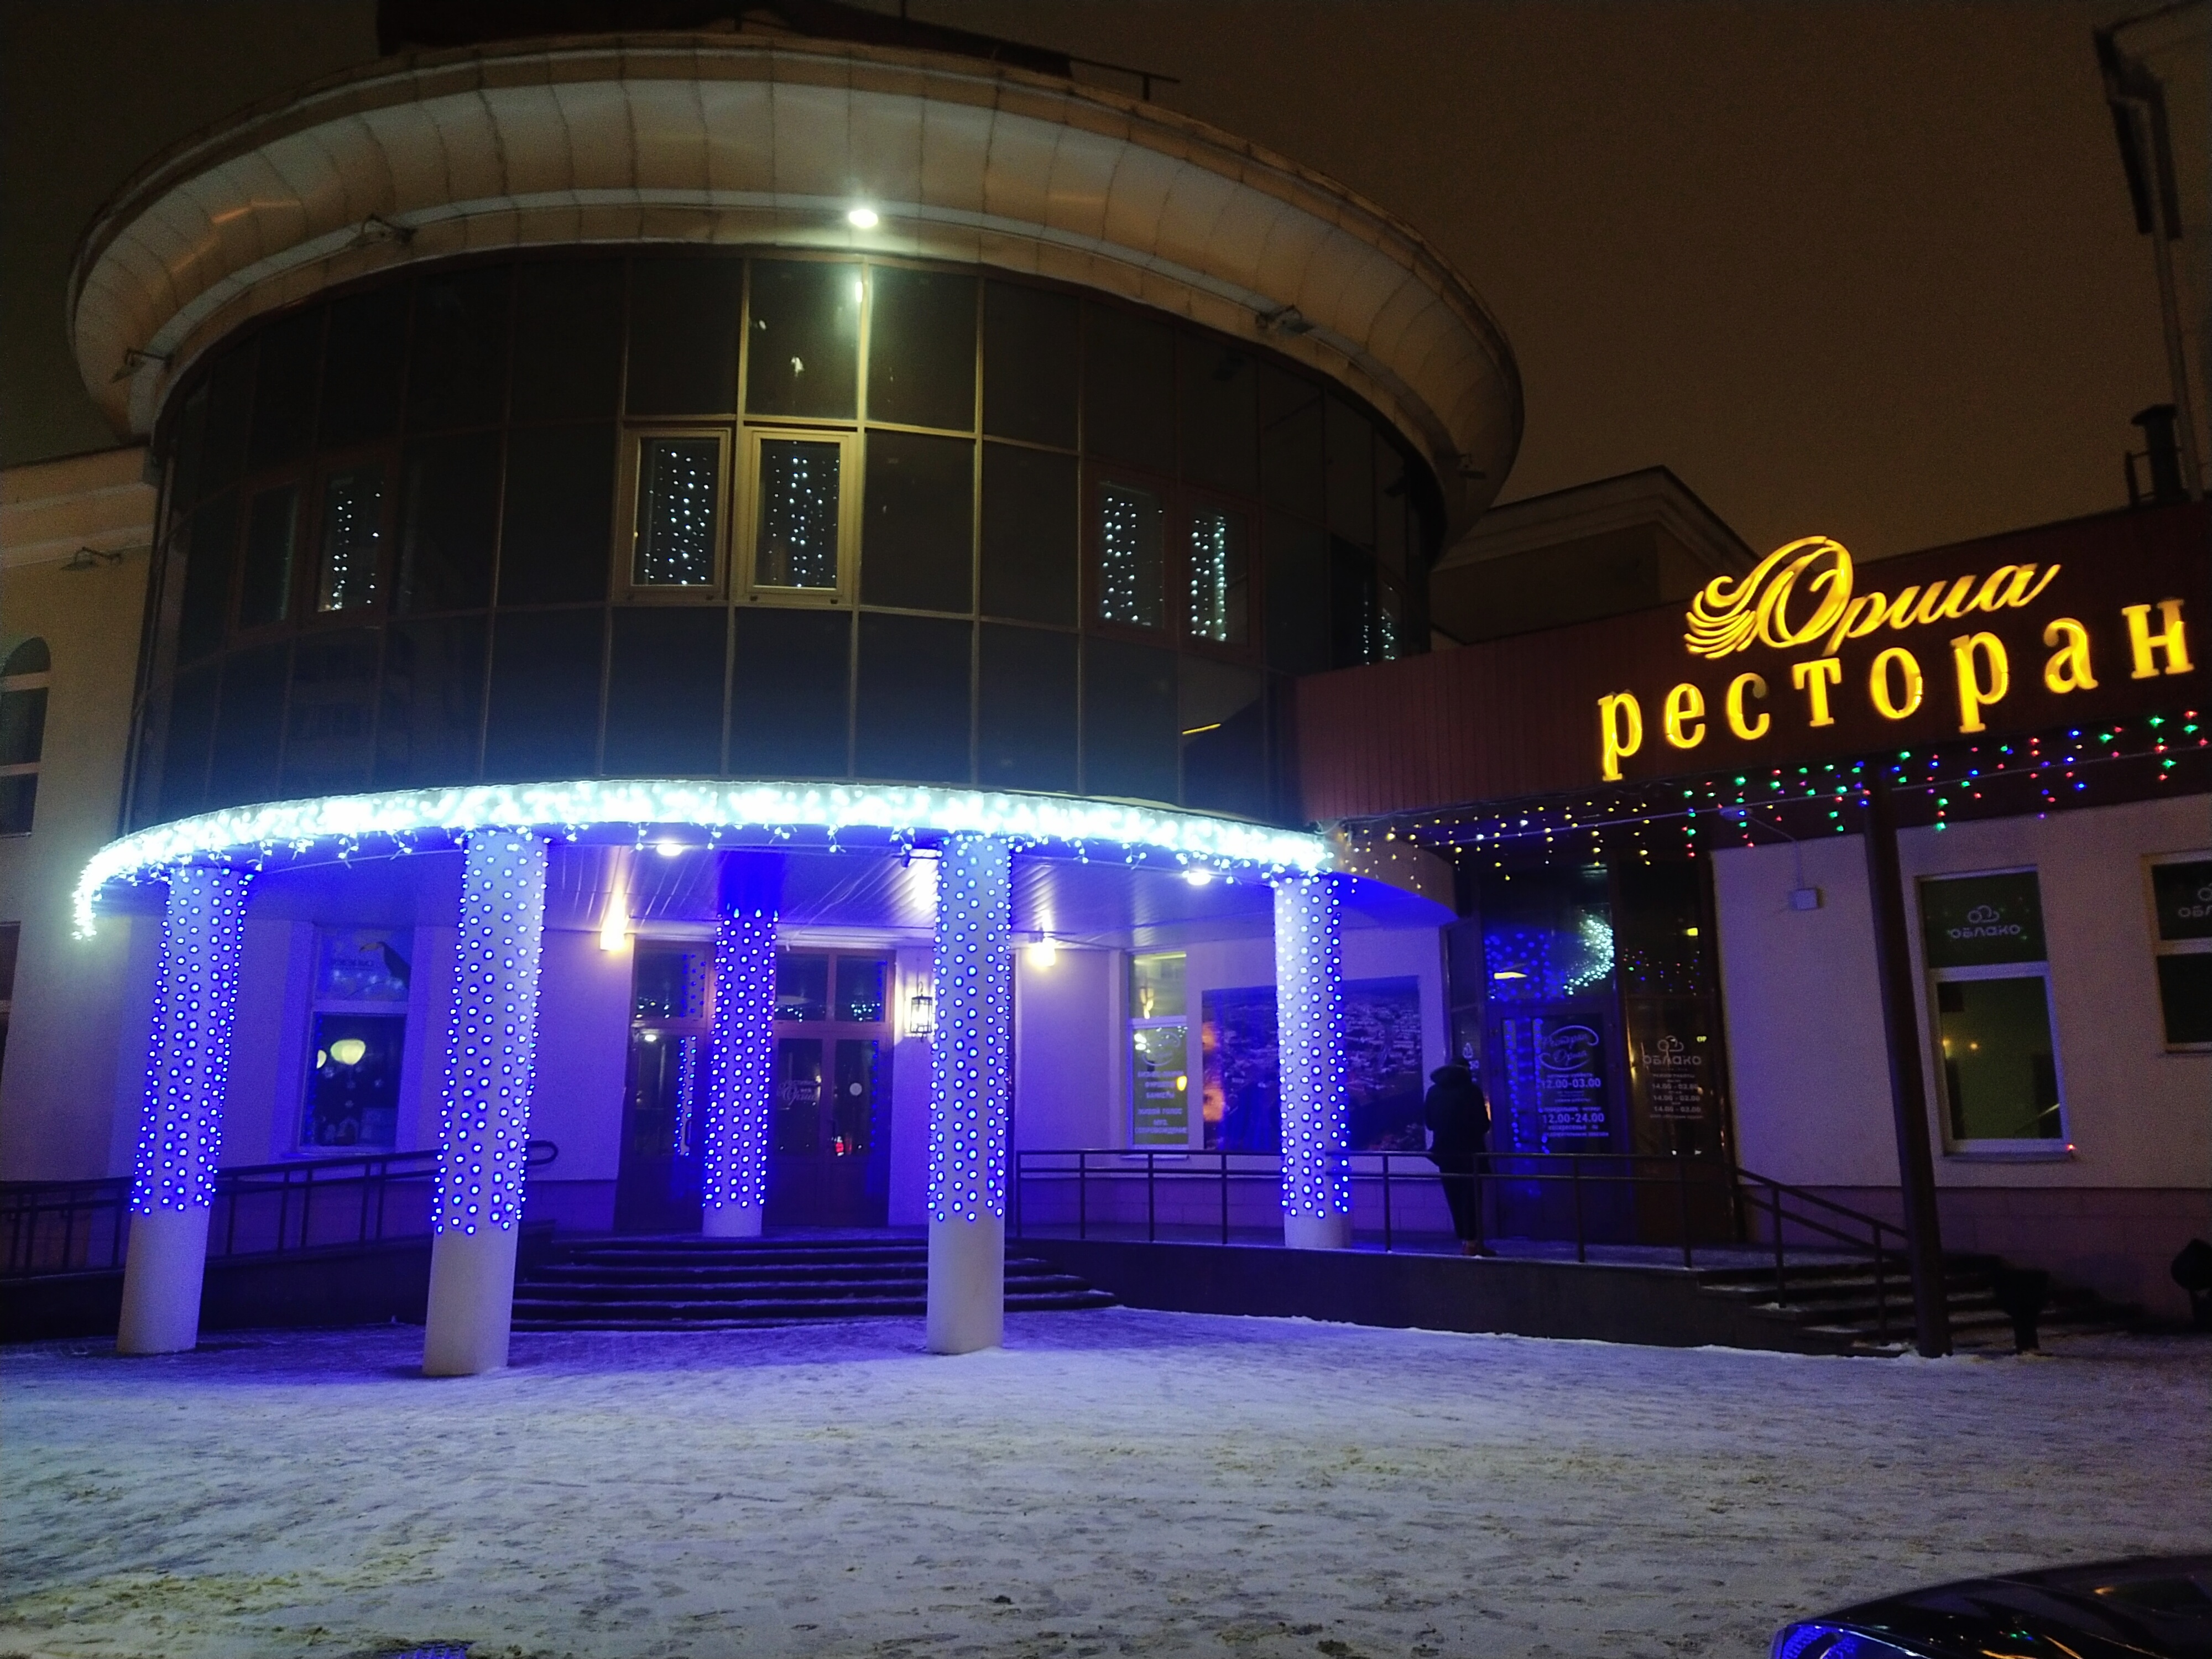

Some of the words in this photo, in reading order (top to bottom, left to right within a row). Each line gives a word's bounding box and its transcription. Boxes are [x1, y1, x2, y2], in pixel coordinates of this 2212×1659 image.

[1742, 535, 2062, 657] Орша
[1597, 597, 2195, 782] ресторан
[1542, 1112, 1605, 1124] 12.00-24.00
